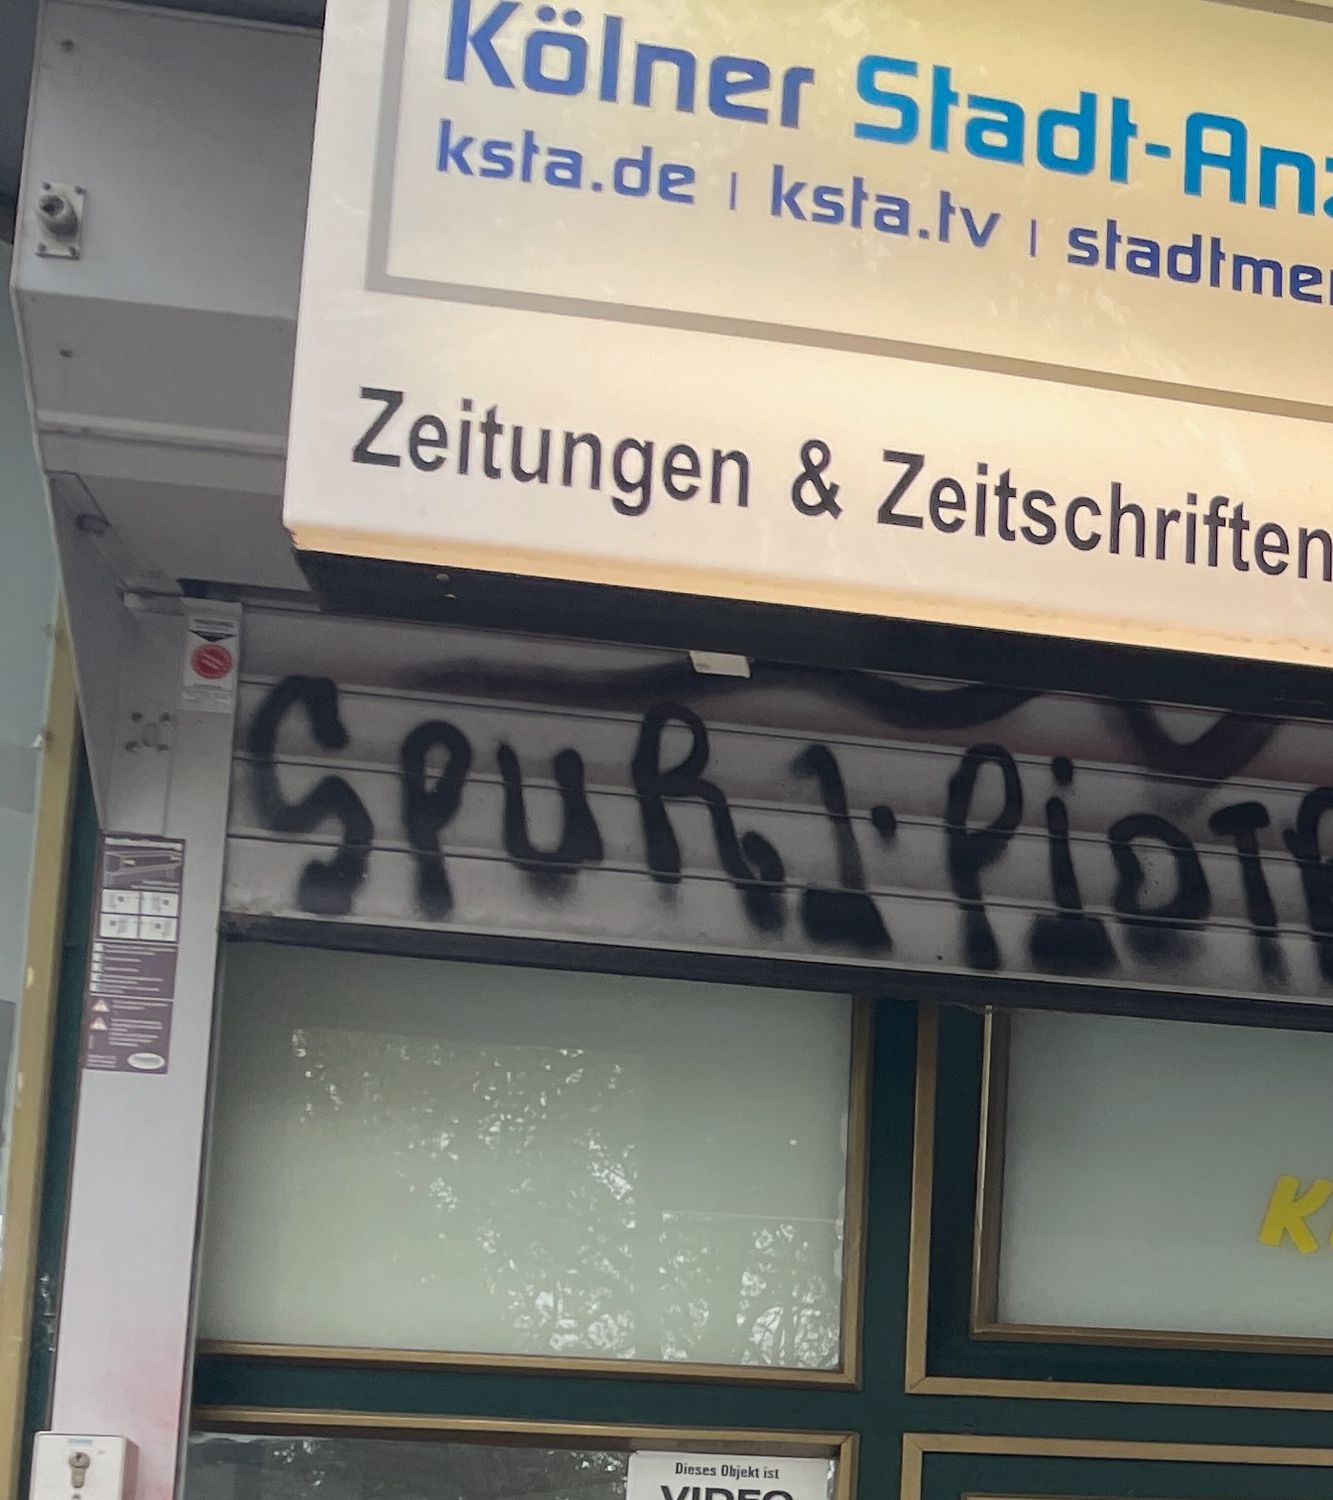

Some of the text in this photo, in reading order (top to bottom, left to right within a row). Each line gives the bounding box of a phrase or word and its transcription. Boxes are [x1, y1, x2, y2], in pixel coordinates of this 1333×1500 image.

[445, 1, 814, 130] Kölner
[437, 119, 695, 205] ksta.de
[771, 165, 1000, 247] ksta.tv
[352, 386, 1333, 583] Zeitungen & Zeitschriften
[675, 1462, 780, 1480] Dieses Objekt ist
